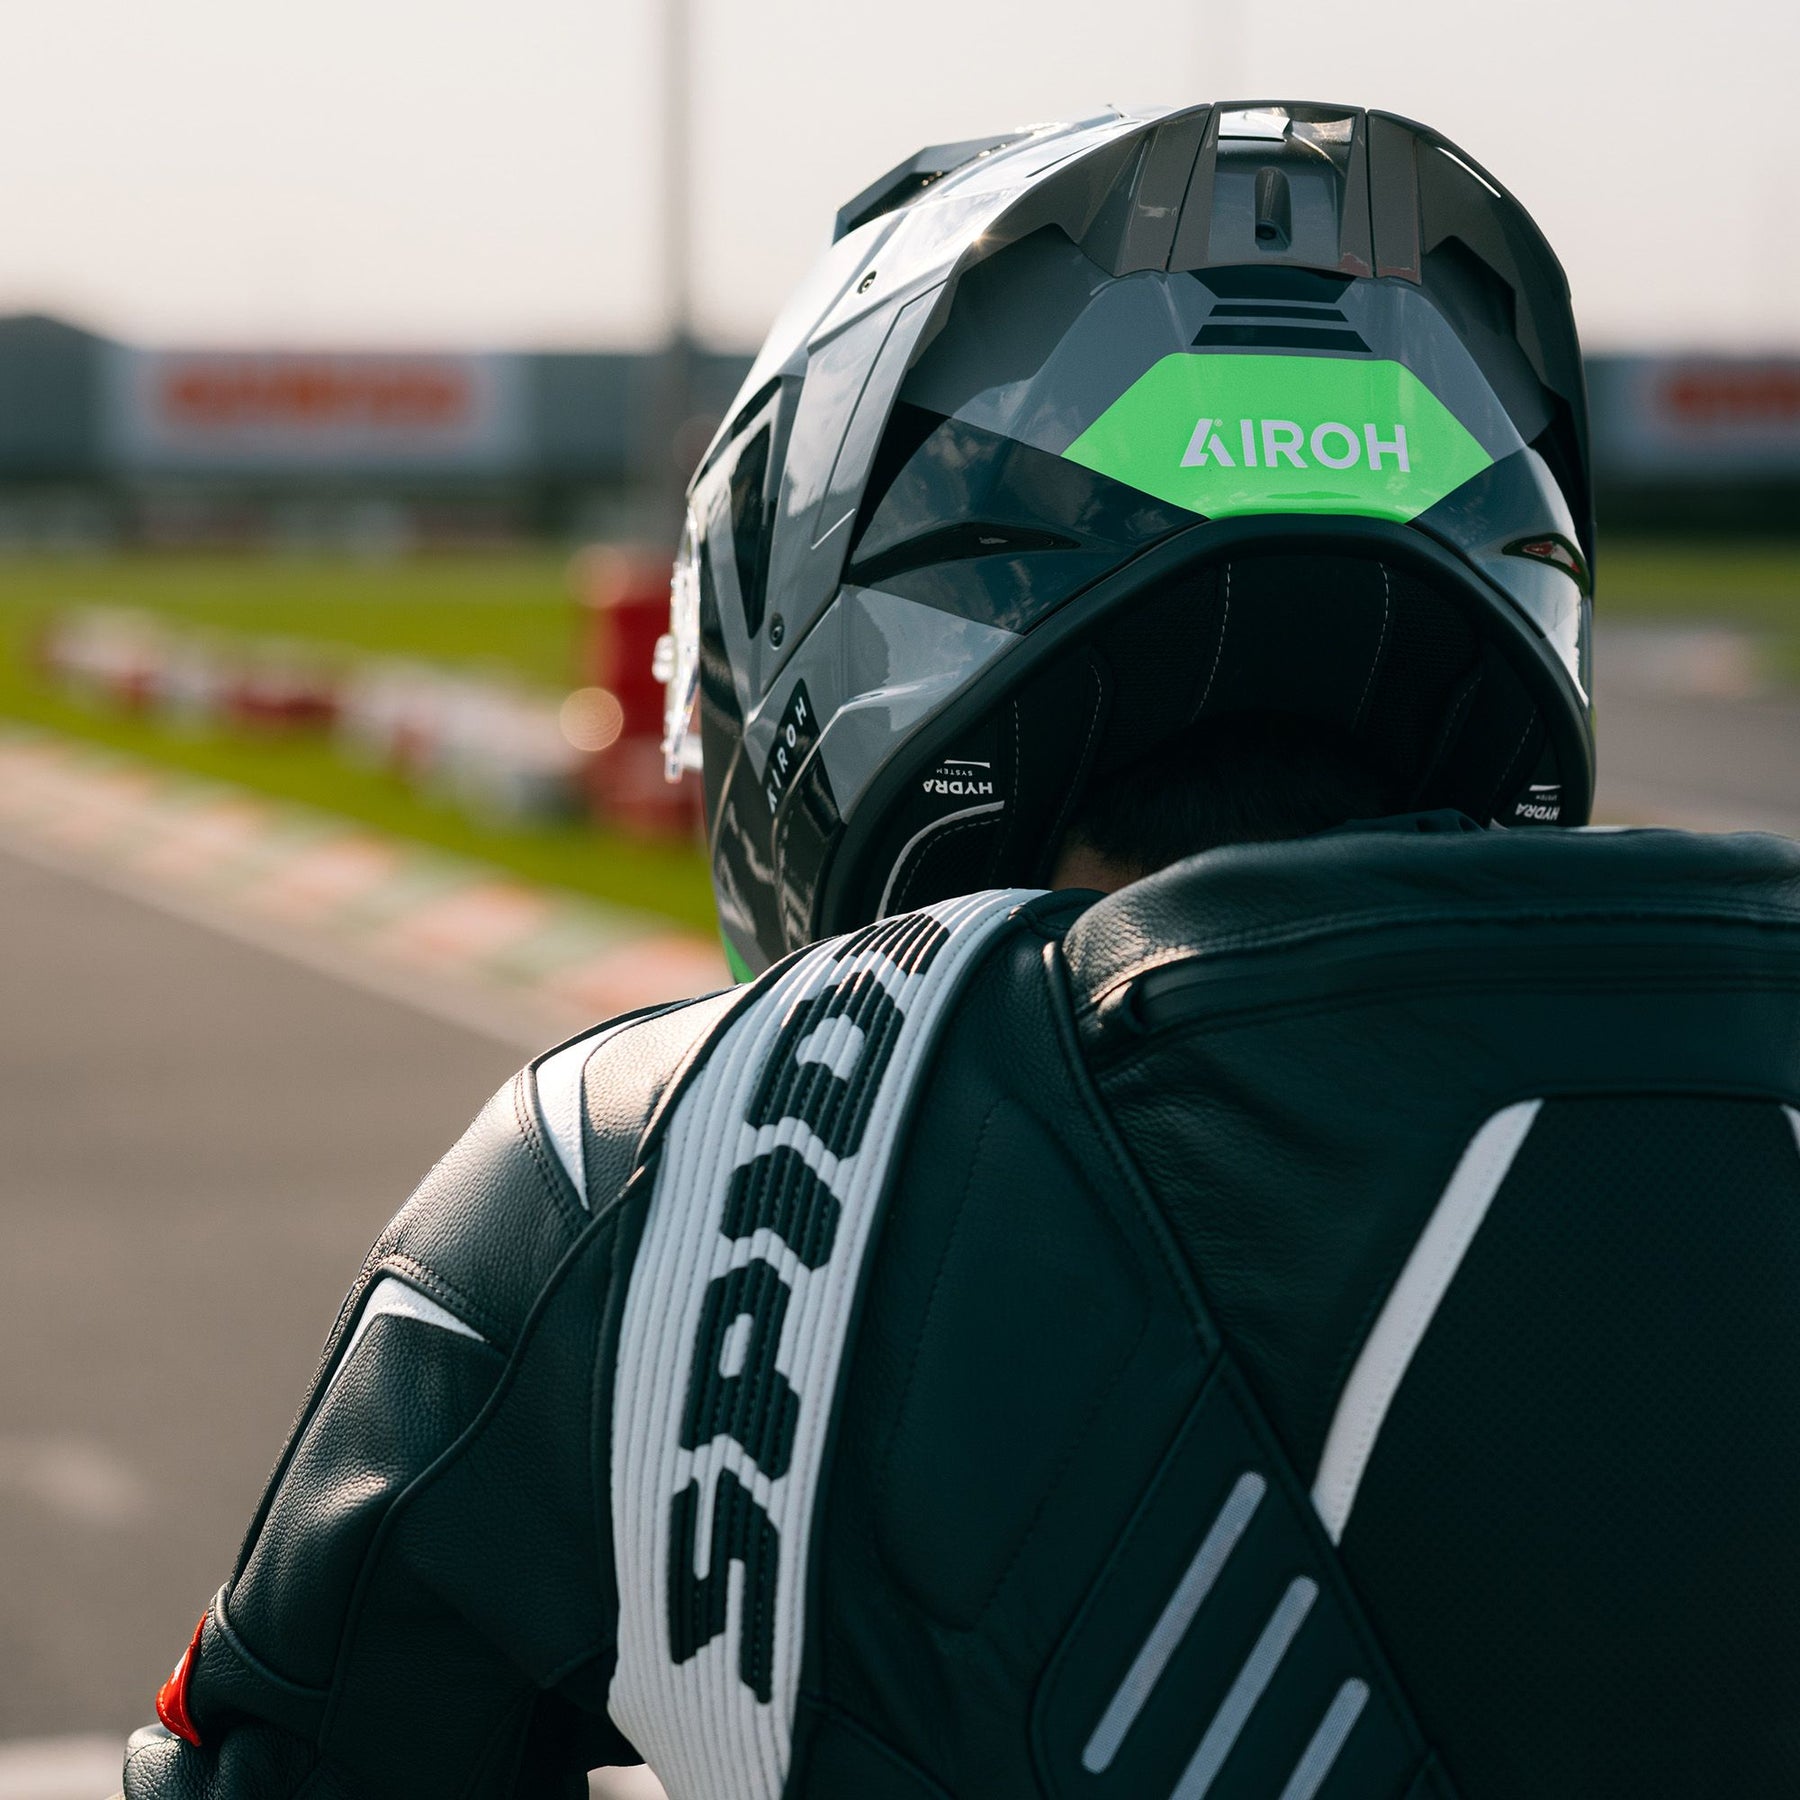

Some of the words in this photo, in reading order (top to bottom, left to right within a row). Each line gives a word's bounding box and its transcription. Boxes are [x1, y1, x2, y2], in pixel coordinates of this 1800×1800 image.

[1180, 418, 1411, 472] AIROH
[767, 697, 807, 813] AIROH
[936, 768, 973, 776] SYSTEM
[923, 779, 993, 794] HYDRA
[1515, 803, 1561, 820] HYDRA
[669, 913, 950, 1703] SPIDI
